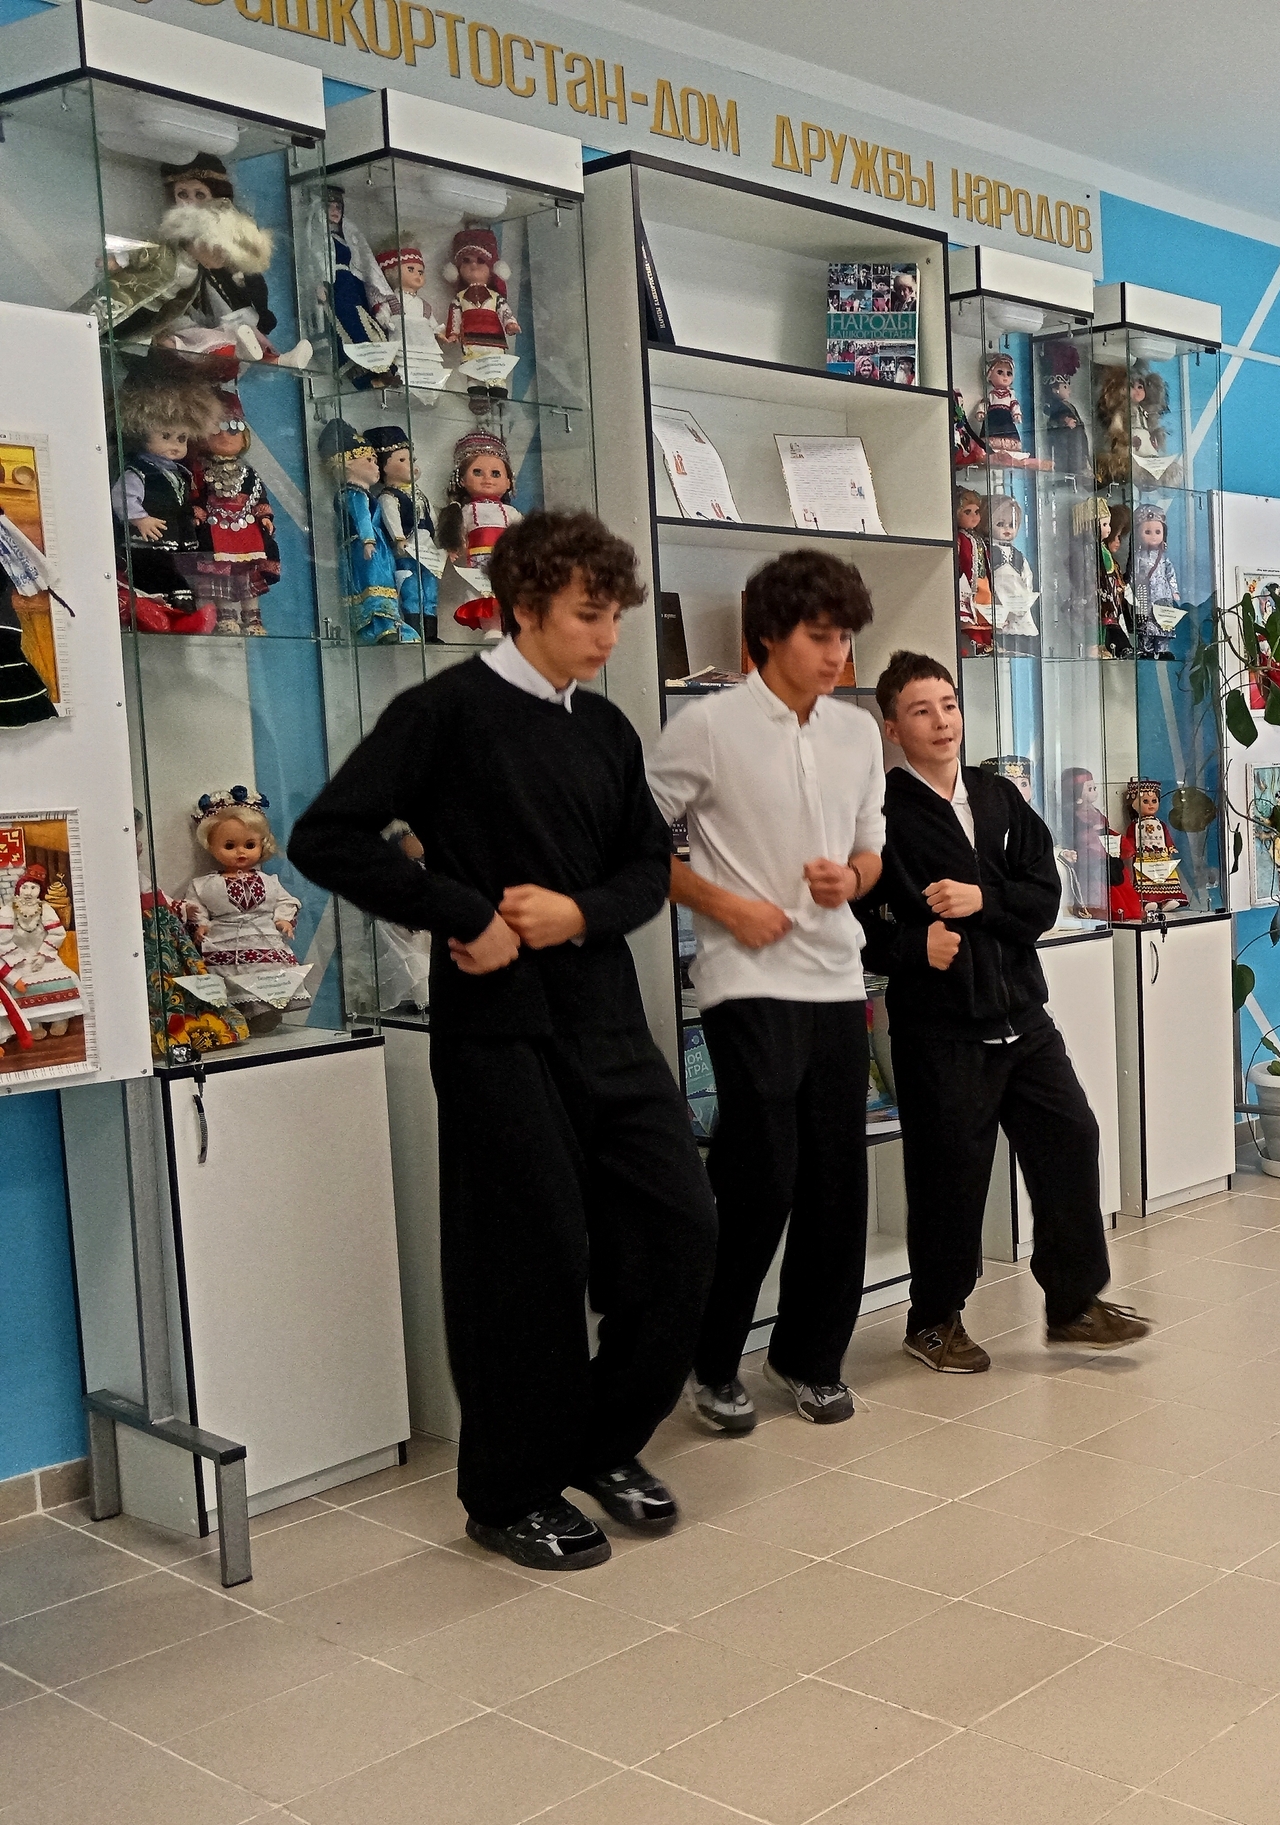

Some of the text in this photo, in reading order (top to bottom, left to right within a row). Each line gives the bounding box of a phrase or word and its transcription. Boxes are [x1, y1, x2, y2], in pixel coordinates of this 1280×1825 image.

[771, 114, 937, 211] ДРУЖБЫ
[830, 313, 914, 331] НАРОДЫ
[830, 330, 914, 339] БАШКОРТОСТАНА
[687, 1051, 703, 1065] ОЯ
[687, 1061, 709, 1078] ГРА
